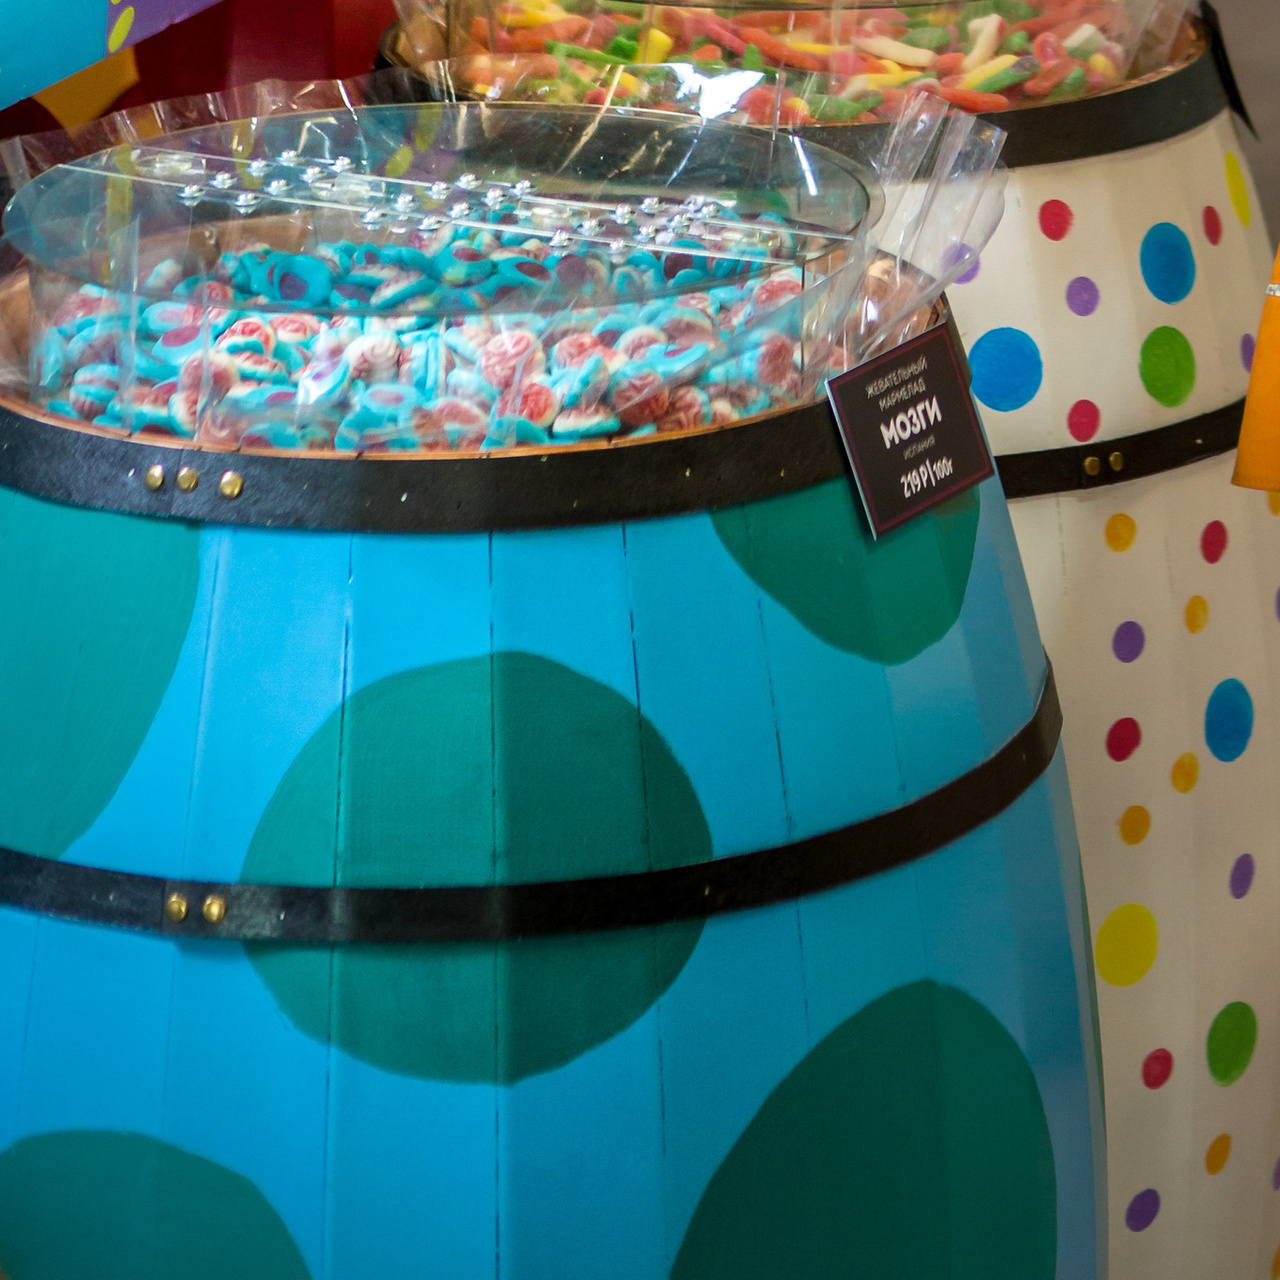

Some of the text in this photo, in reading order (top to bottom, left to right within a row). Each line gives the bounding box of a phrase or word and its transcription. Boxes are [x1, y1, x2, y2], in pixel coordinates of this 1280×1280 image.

[866, 355, 927, 398] ЖЕВАТЕЛЬНЫЙ
[879, 377, 926, 411] МАРМЕЛАД
[880, 396, 942, 449] МОЗГИ
[903, 434, 936, 461] ИСПАНИЯ
